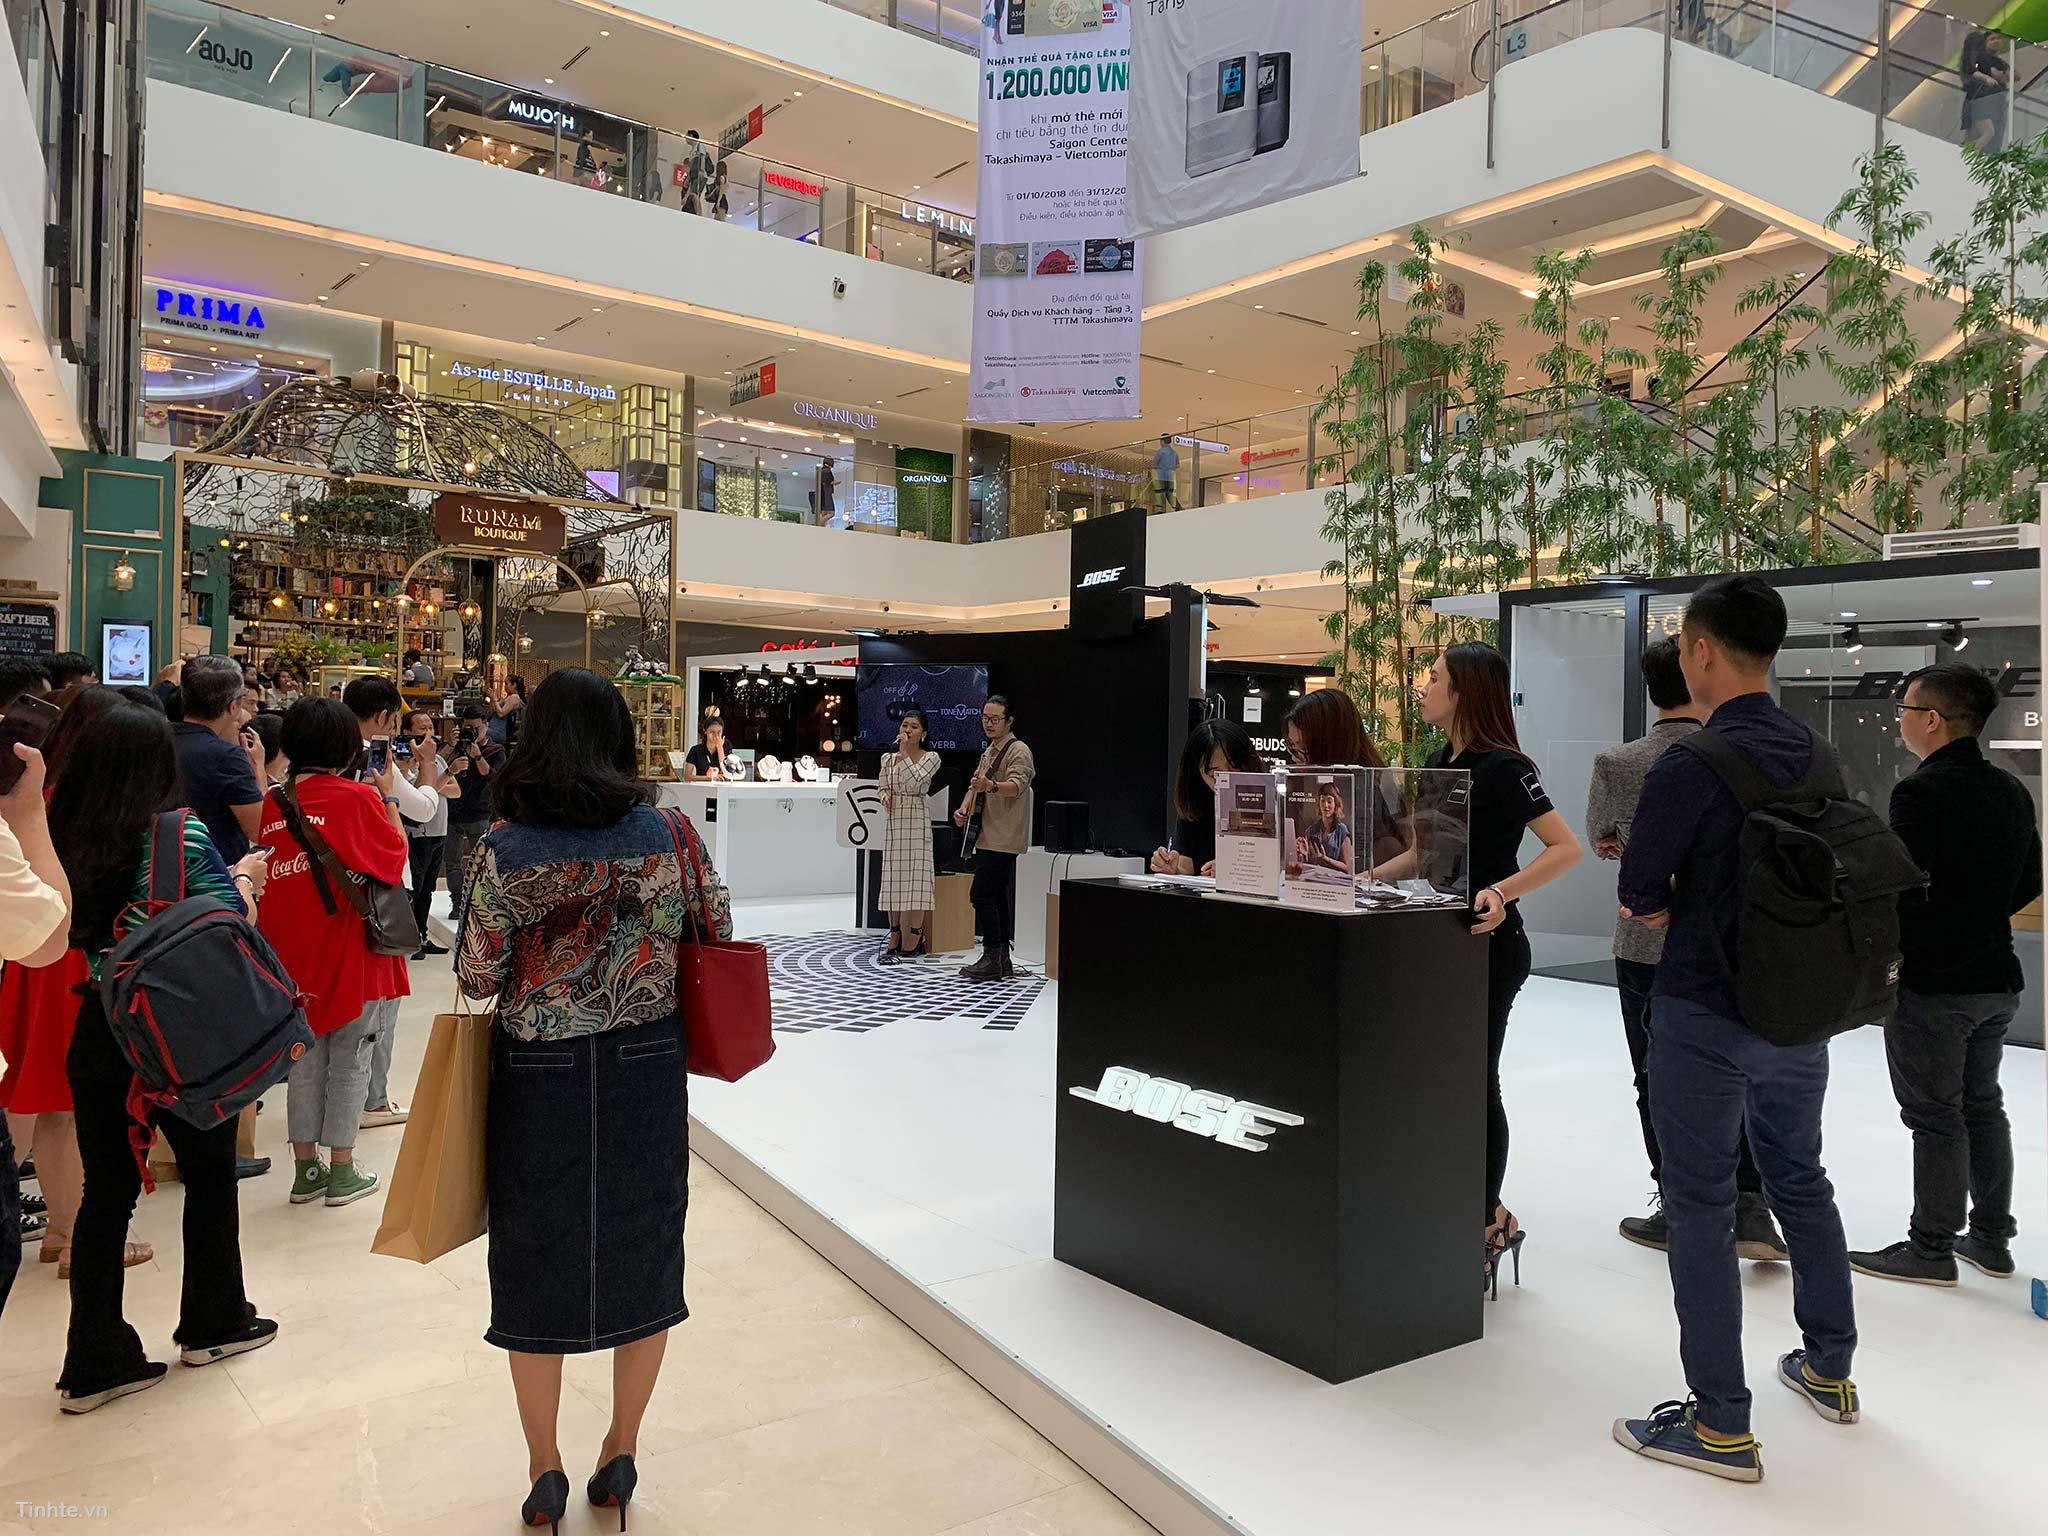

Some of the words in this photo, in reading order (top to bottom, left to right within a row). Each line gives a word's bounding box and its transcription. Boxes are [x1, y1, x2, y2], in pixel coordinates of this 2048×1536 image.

[1082, 20, 1098, 28] VISA
[1507, 33, 1527, 54] L3
[986, 64, 1092, 101] 1.200.000
[1031, 114, 1047, 125] khi
[996, 130, 1011, 141] chi
[1049, 138, 1086, 150] Saigon
[1090, 136, 1128, 147] Centre
[984, 152, 1053, 165] Takashimaya
[1016, 190, 1066, 201] 01/10/2018
[1086, 186, 1127, 197] 31/12/20
[902, 202, 973, 237] LEMIN
[156, 289, 265, 329] PRIMA
[160, 316, 185, 328] PRIMA
[187, 320, 209, 331] GOLD
[1053, 317, 1079, 325] TTTM
[1081, 315, 1133, 325] Takashimaya
[219, 327, 244, 337] PRIMA
[245, 331, 260, 340] ART
[450, 361, 500, 381] As-me
[503, 368, 573, 393] ESTELLE
[575, 381, 617, 400] Japan
[1082, 387, 1131, 396] Vietcombank
[503, 392, 569, 408] JEWELRY
[793, 400, 878, 430] ORGANIQUE
[902, 475, 948, 484] ORGANQUE
[474, 527, 528, 542] BOUTIQUE
[1076, 566, 1126, 589] BOSE
[24, 614, 50, 627] BEER
[940, 706, 982, 717] TONEMATCH
[1068, 1065, 1305, 1153] BOSE
